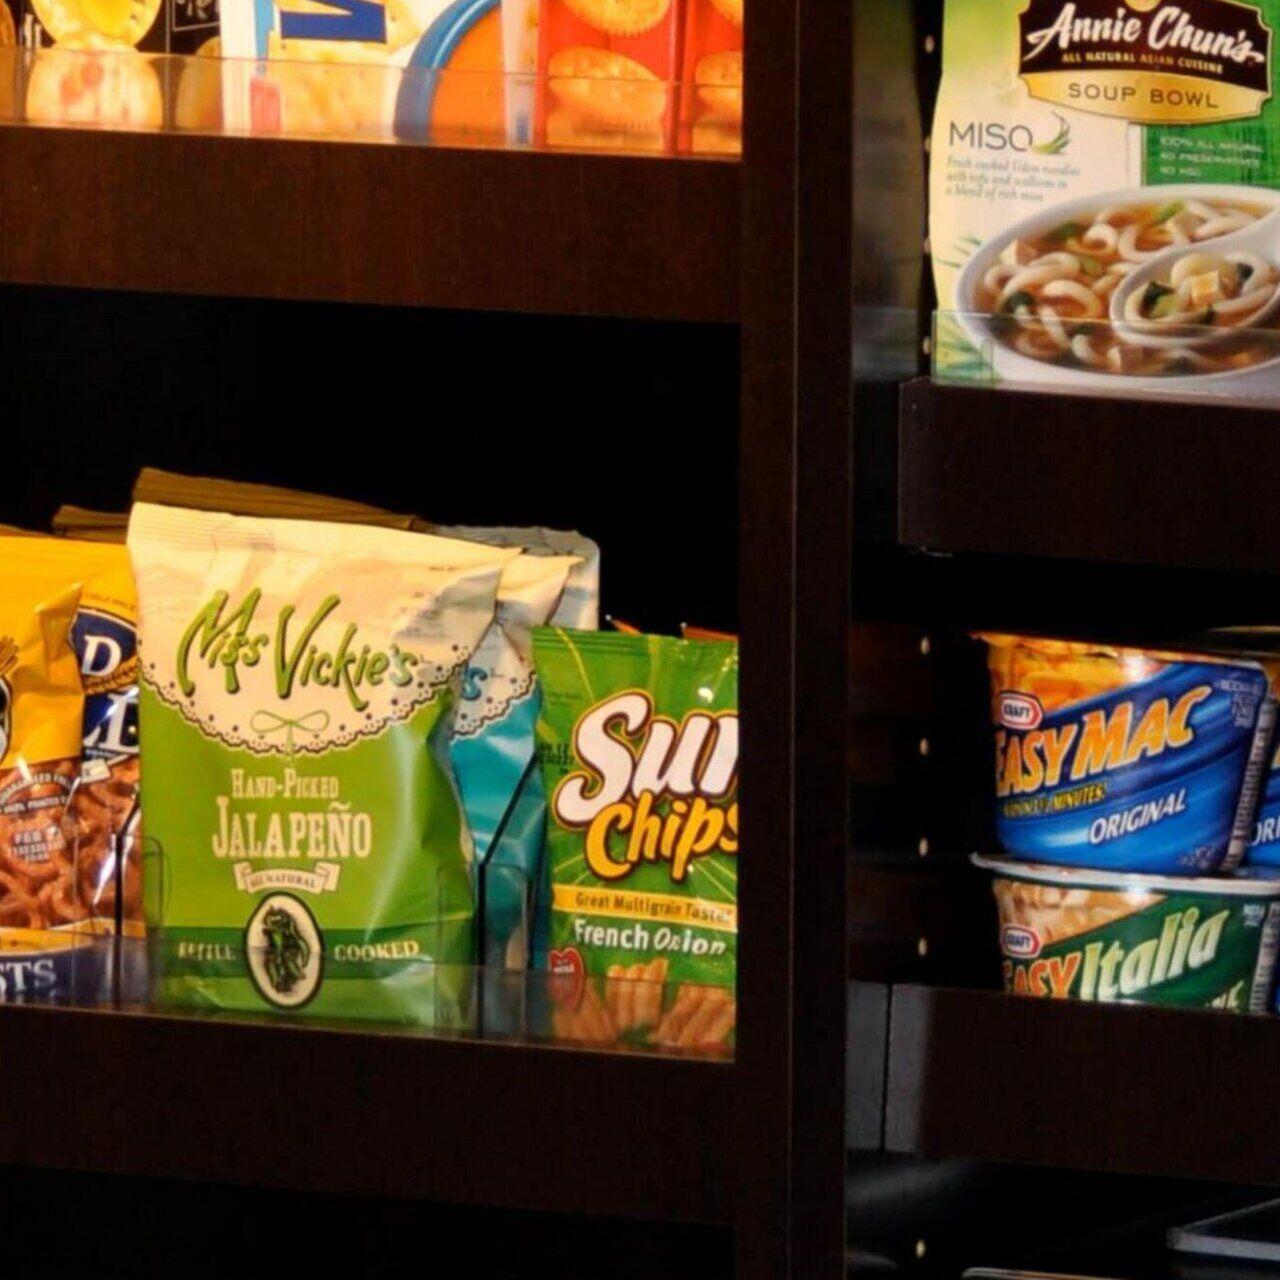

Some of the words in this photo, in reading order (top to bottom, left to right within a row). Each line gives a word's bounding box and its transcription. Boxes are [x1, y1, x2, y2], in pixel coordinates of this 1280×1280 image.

[1023, 2, 1141, 61] Annie
[1147, 6, 1265, 65] Chun's
[1062, 52, 1082, 63] ALL
[1086, 53, 1136, 64] NATURAL
[1178, 58, 1224, 74] CUISINE
[1068, 82, 1138, 101] SOUP
[1150, 87, 1219, 109] BOWL
[949, 119, 1033, 152] MISO
[176, 587, 268, 698] Miss
[274, 593, 420, 712] Vickie's
[1070, 685, 1212, 782] MAC
[552, 688, 738, 830] Sun
[231, 768, 340, 798] HAND-PICKED
[211, 795, 372, 860] JALAPEÑO
[1088, 788, 1187, 846] ORIGINAL
[268, 874, 316, 888] NATURAL
[575, 890, 611, 908] Great
[613, 894, 683, 920] Multigrain
[333, 939, 420, 963] COOKED
[574, 918, 651, 951] French
[653, 924, 726, 955] Onion
